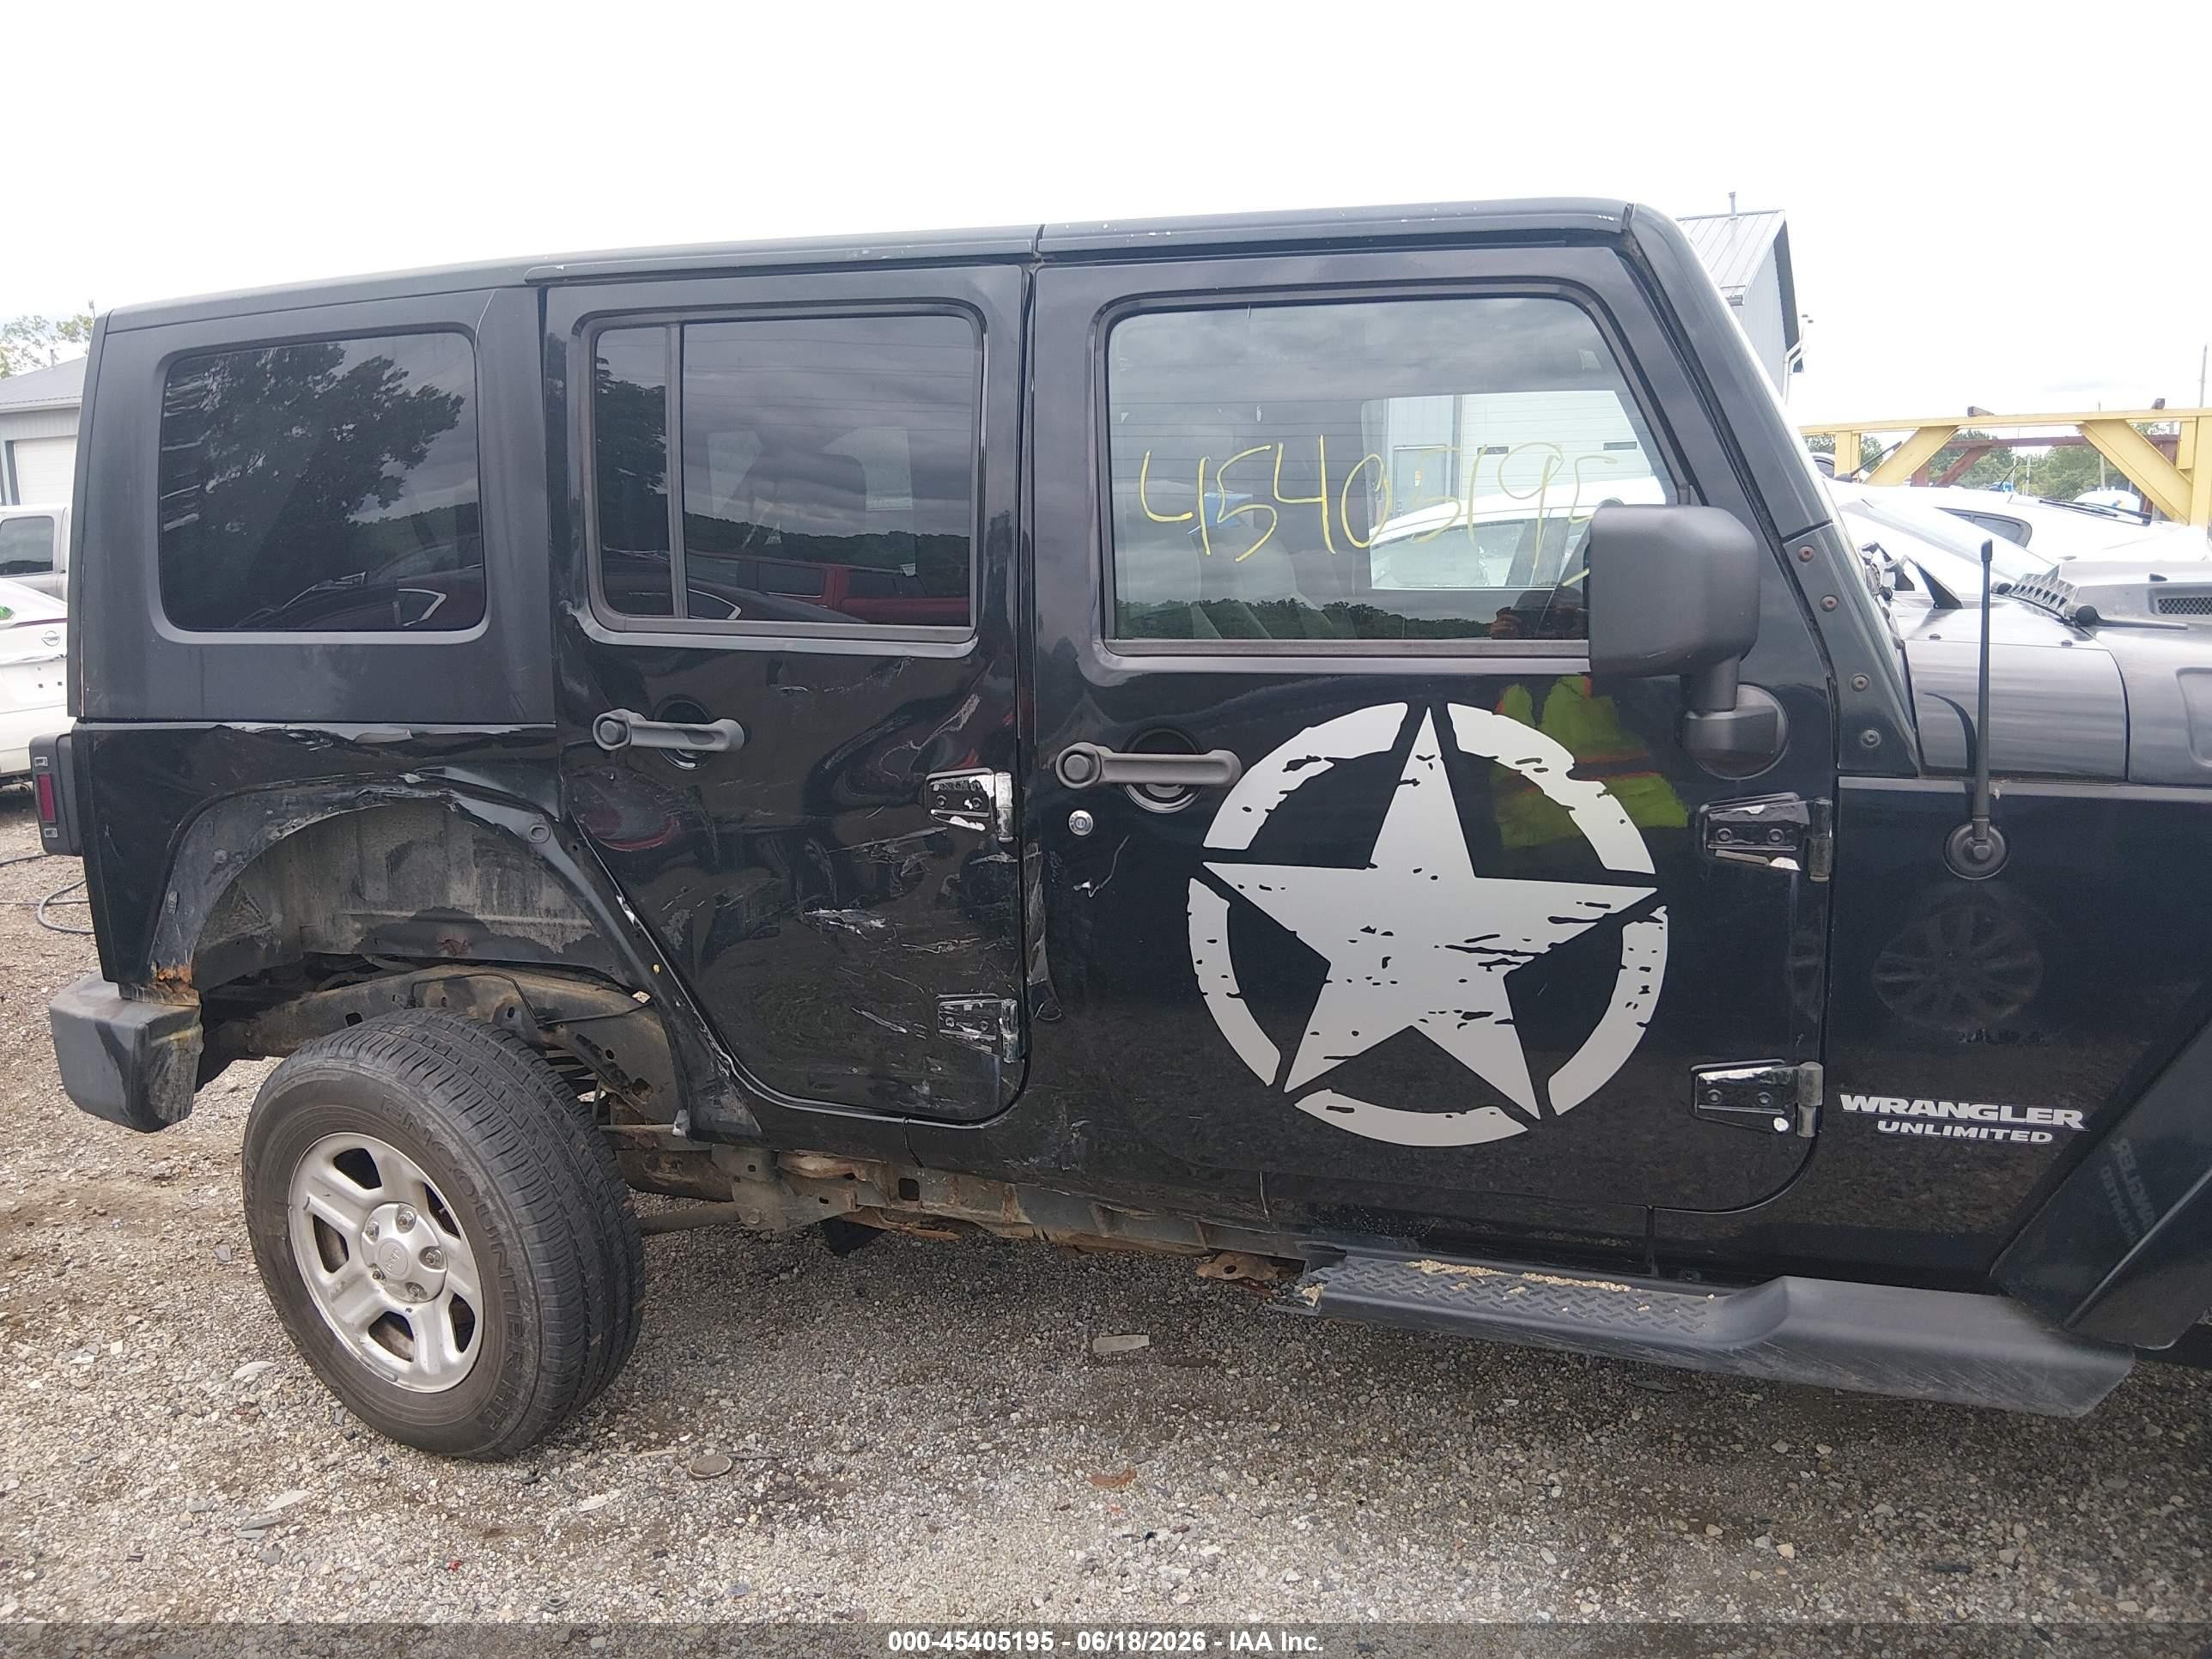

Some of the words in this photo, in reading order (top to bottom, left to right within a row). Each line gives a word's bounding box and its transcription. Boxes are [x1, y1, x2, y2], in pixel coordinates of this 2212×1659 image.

[1838, 1094, 2085, 1129] WRANGLER
[1877, 1120, 2054, 1143] UNLIMITED
[380, 1093, 524, 1371] ENCOUNTER
